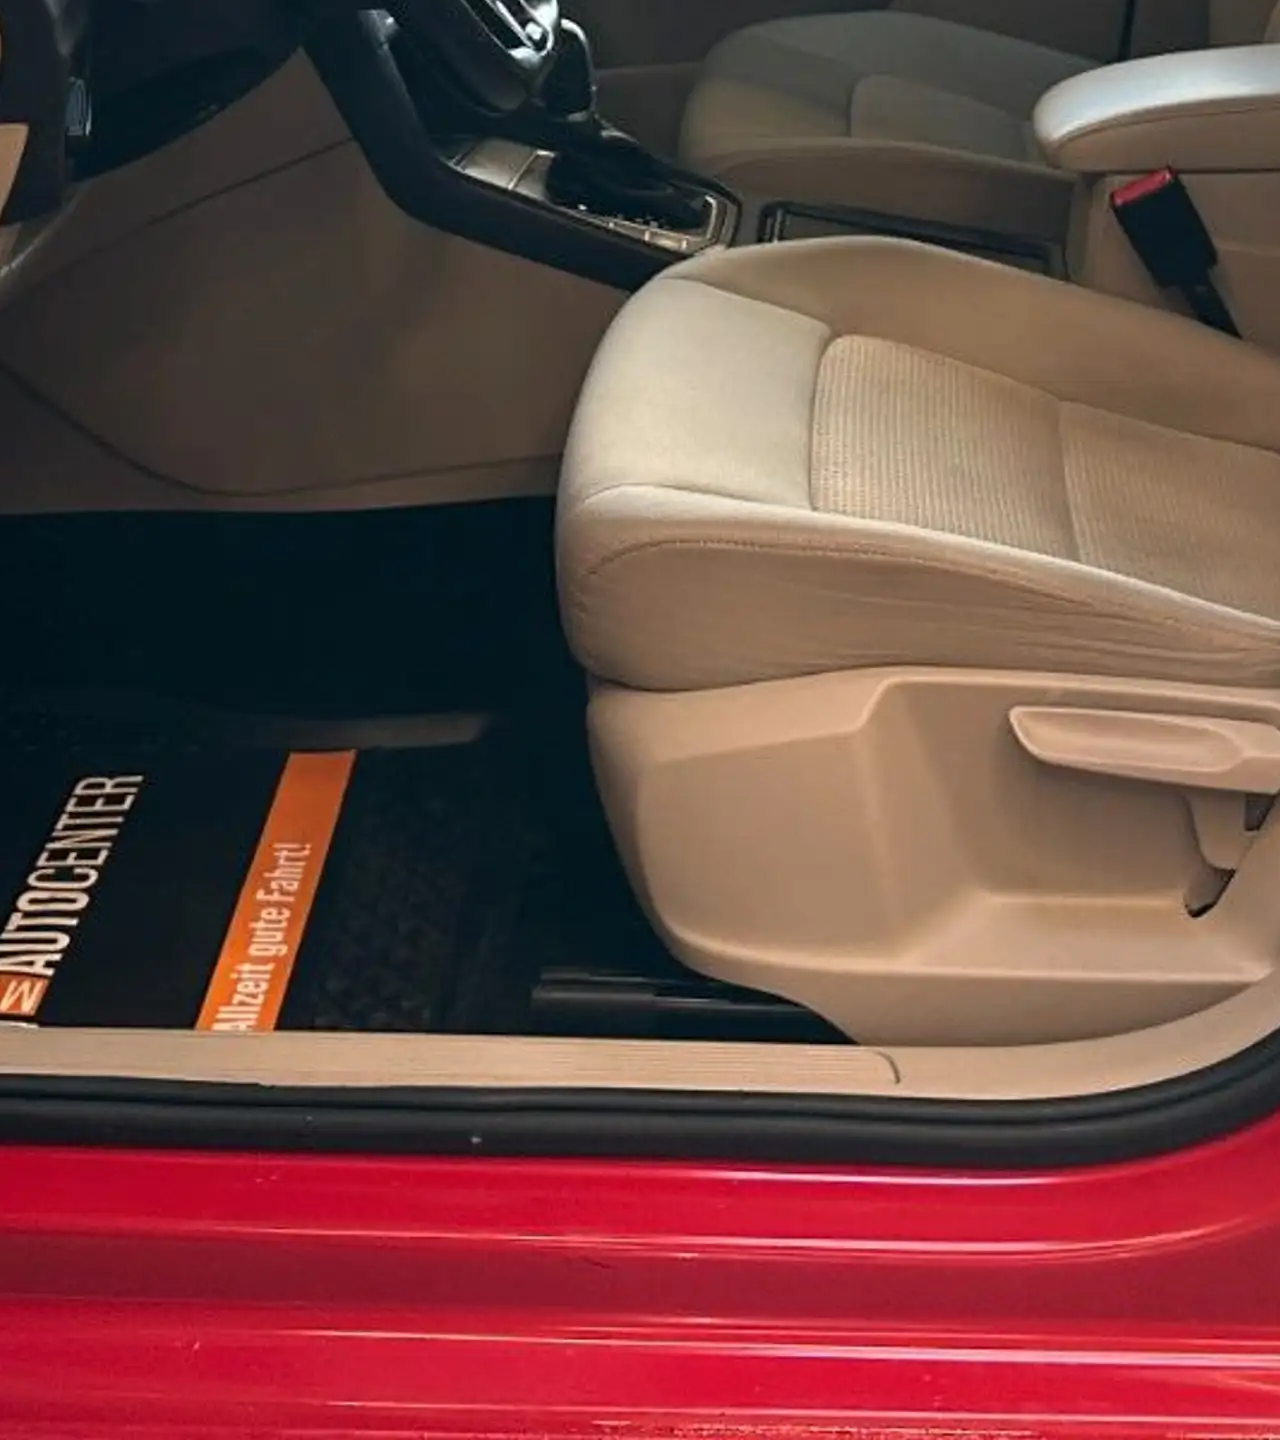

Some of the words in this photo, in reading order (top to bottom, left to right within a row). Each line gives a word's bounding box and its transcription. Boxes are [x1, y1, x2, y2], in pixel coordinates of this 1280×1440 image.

[256, 842, 312, 903] Fahrt!
[248, 906, 292, 957] gute
[211, 962, 277, 1031] Allzeit
